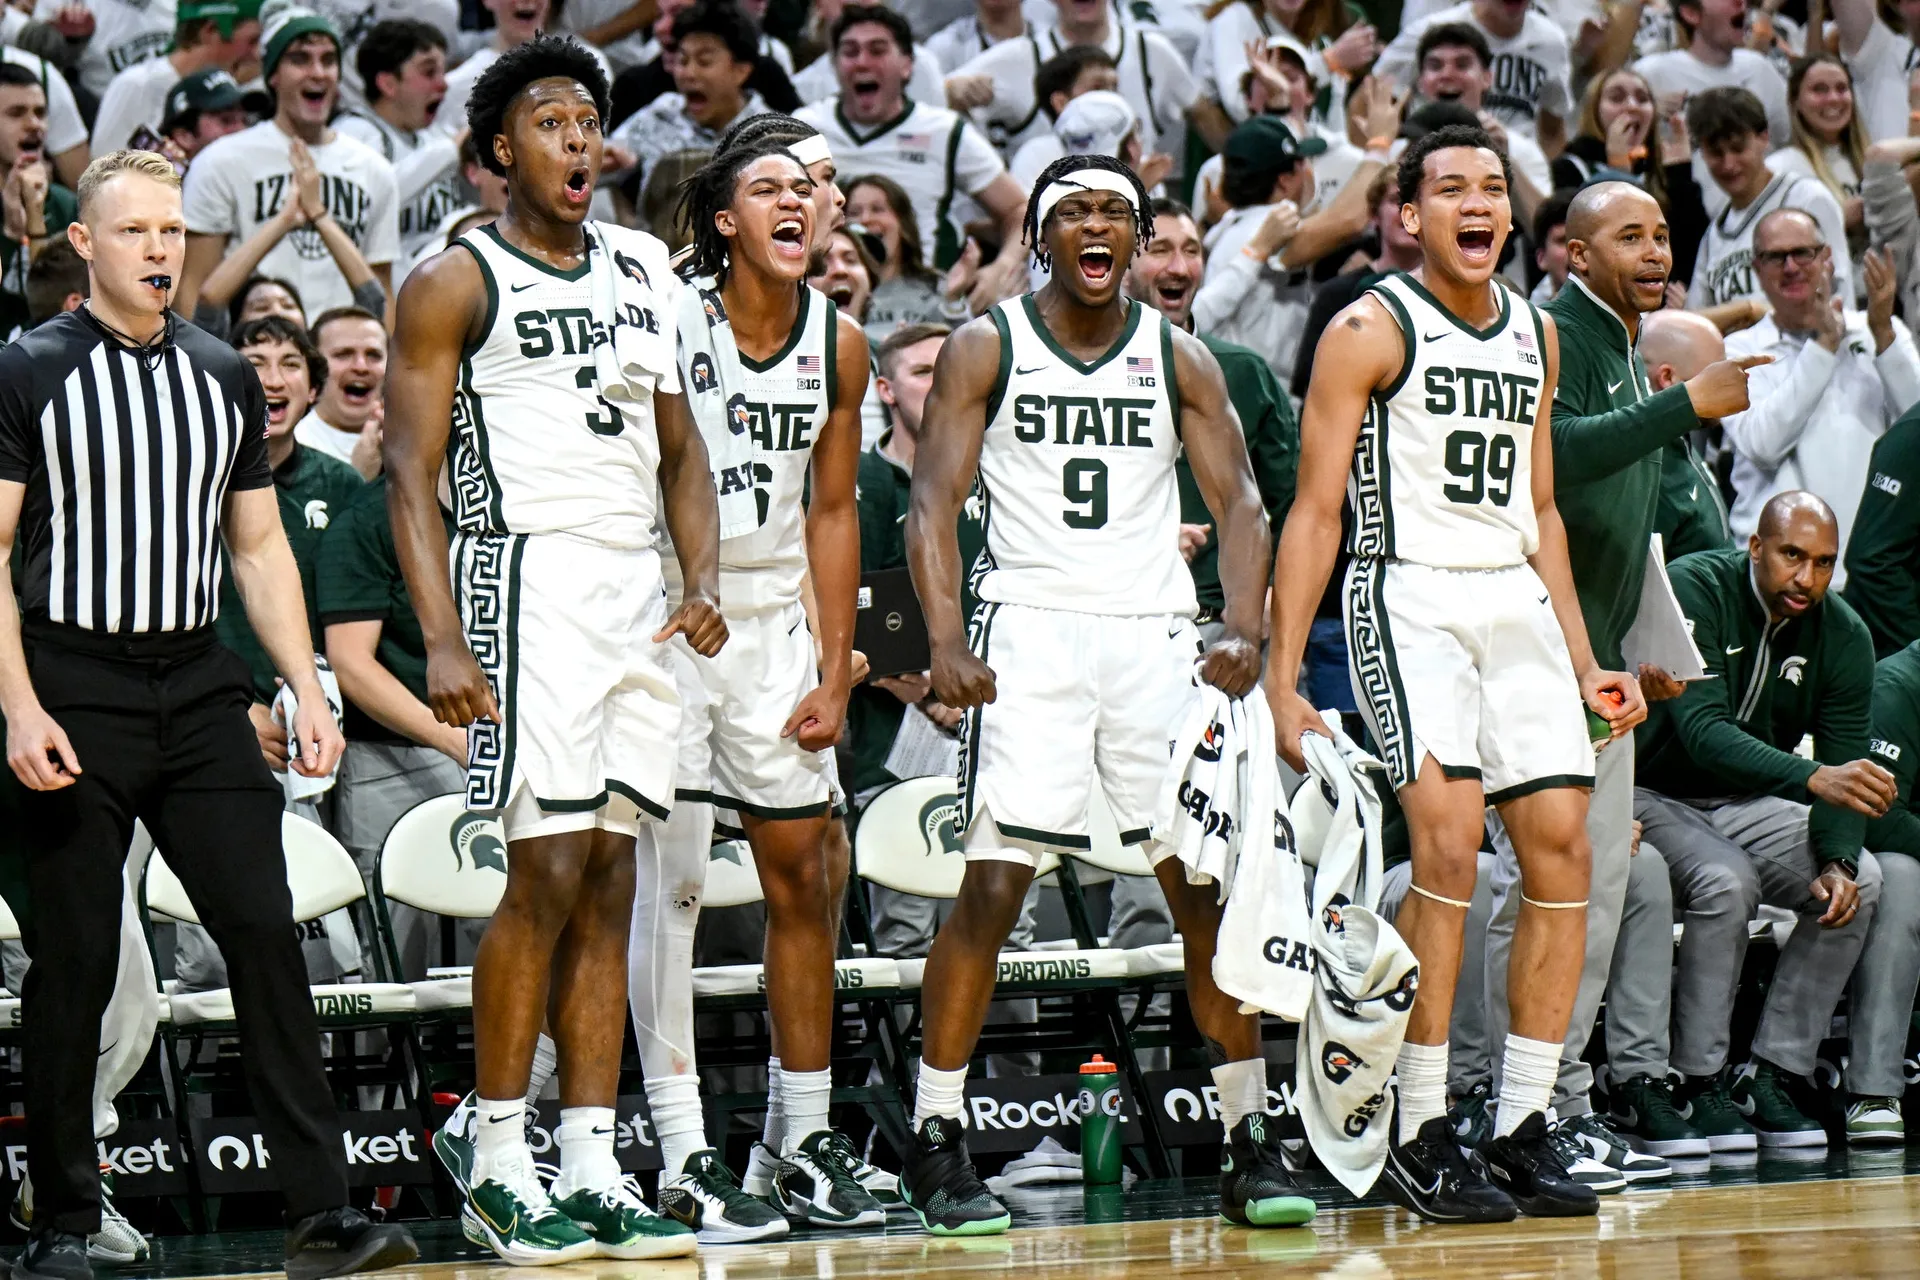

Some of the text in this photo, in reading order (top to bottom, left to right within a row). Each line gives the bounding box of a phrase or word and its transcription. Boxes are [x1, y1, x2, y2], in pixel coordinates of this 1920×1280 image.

[575, 366, 624, 436] 3
[1014, 393, 1157, 448] STATE
[1424, 366, 1540, 427] STATE
[746, 402, 818, 451] ATE
[1063, 458, 1108, 529] 9
[1443, 430, 1516, 507] 99
[998, 958, 1091, 981] PARTANS
[314, 993, 372, 1016] TANS
[970, 1092, 1128, 1131] Rock
